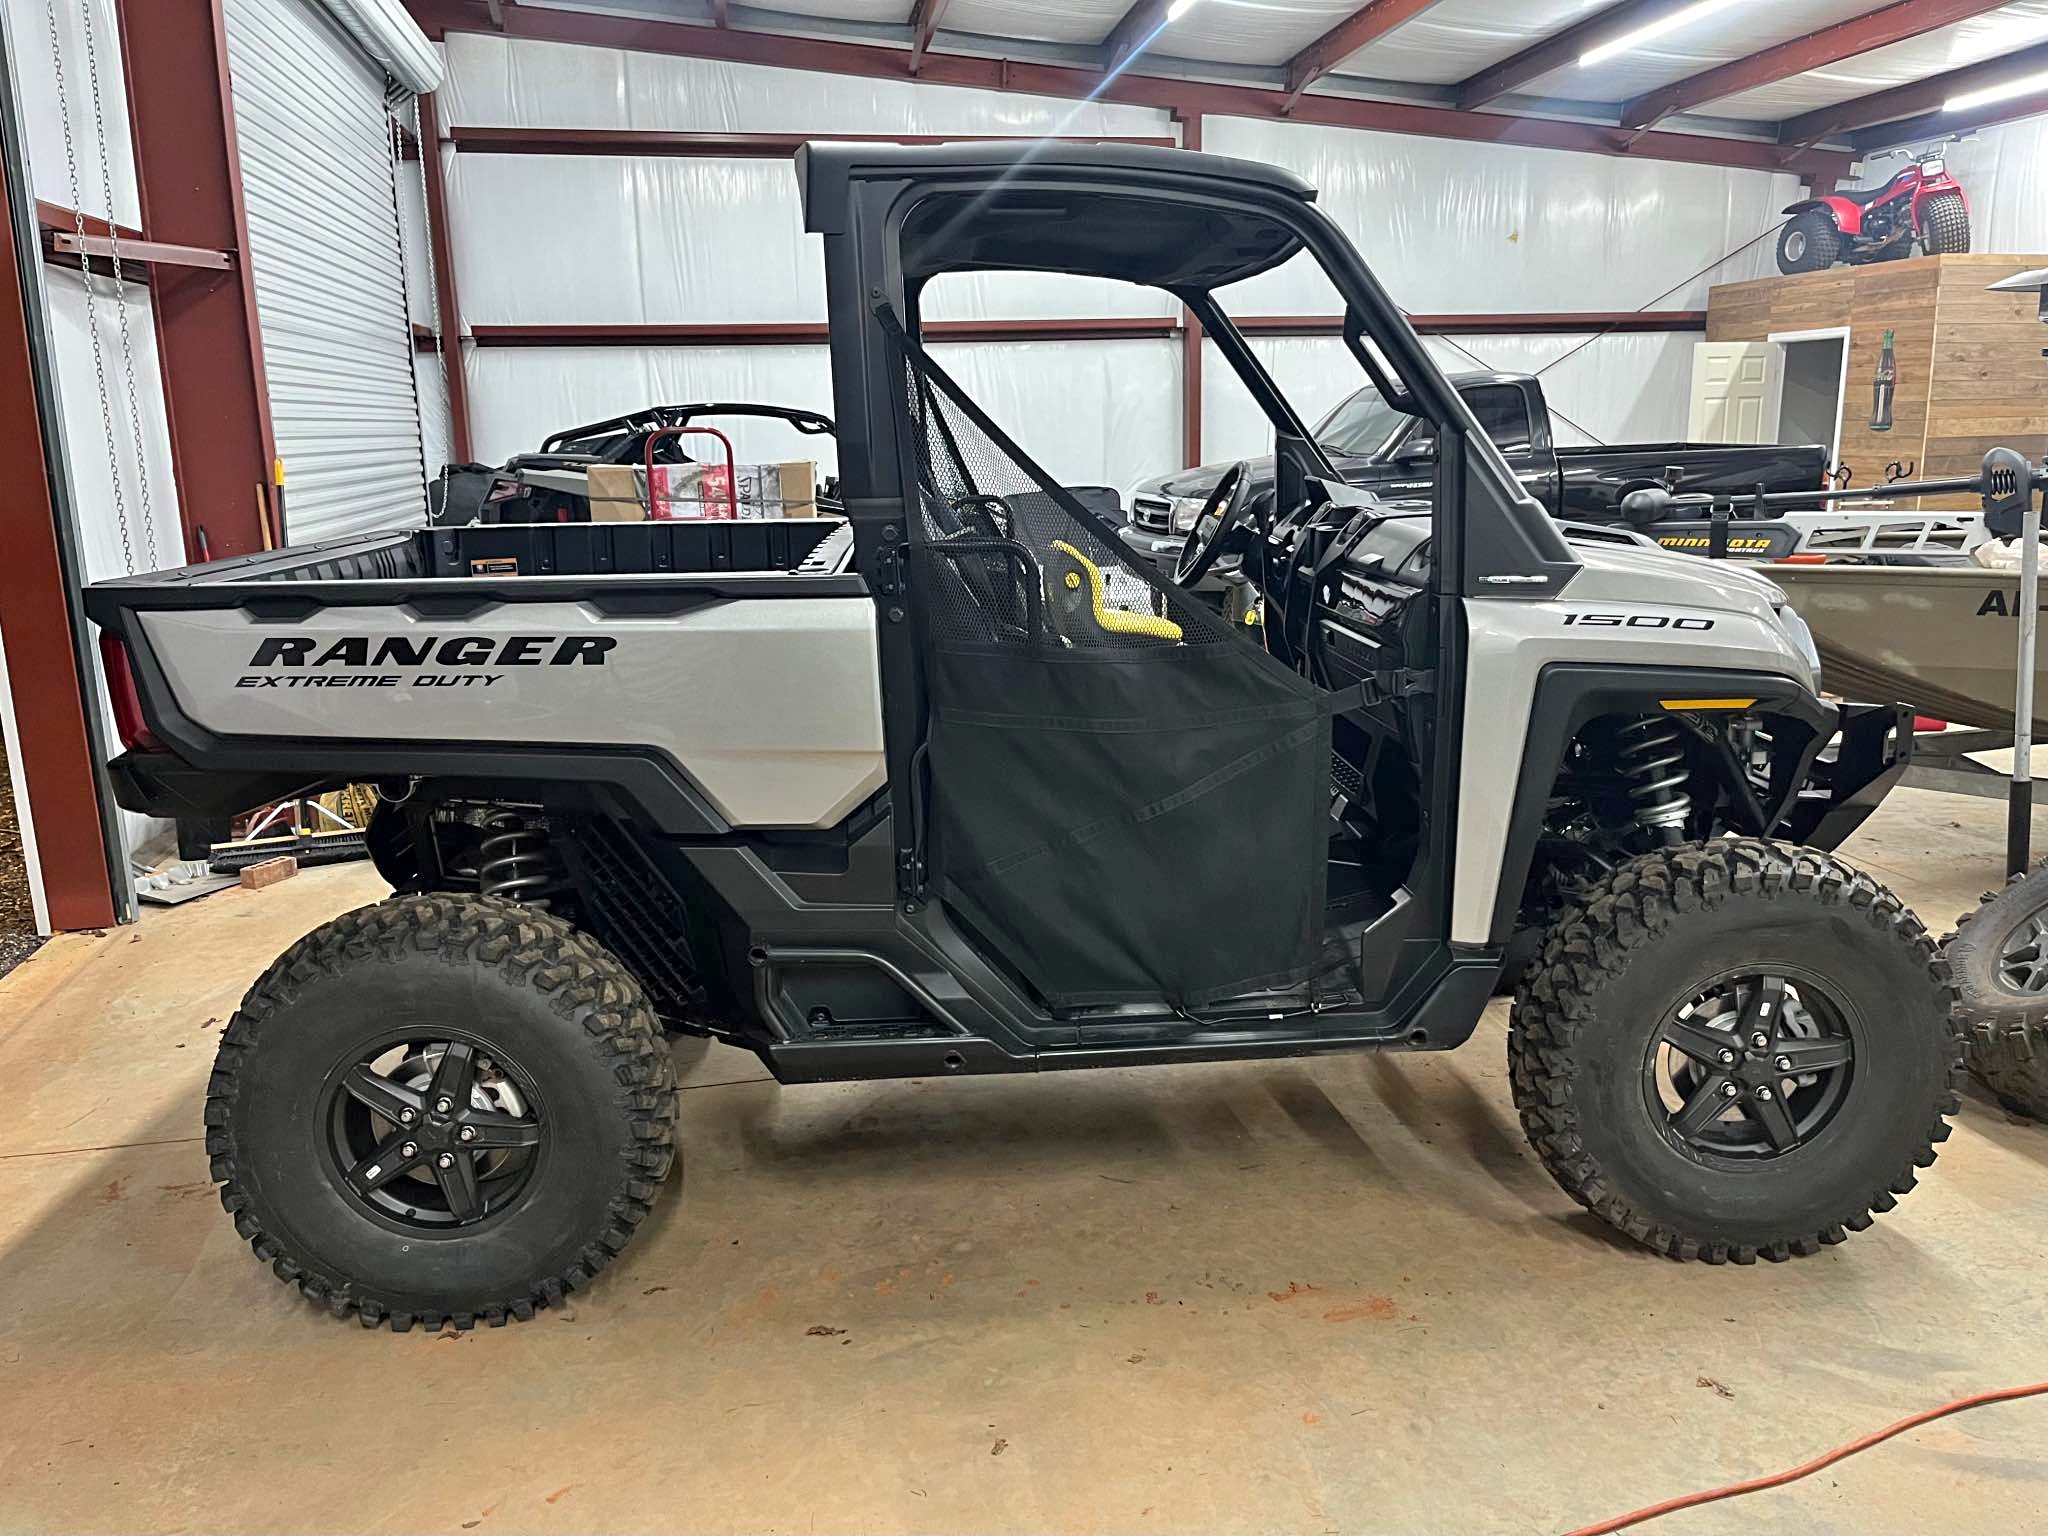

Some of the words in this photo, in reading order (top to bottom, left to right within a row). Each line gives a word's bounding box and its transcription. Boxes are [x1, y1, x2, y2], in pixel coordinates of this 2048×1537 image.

[737, 476, 752, 519] SPALDI
[1657, 538, 1711, 547] MINN
[1726, 539, 1771, 548] OTA
[1563, 614, 1715, 630] 1500
[249, 636, 618, 666] RANGER
[235, 674, 402, 688] EXTREME
[412, 674, 504, 688] DUTY
